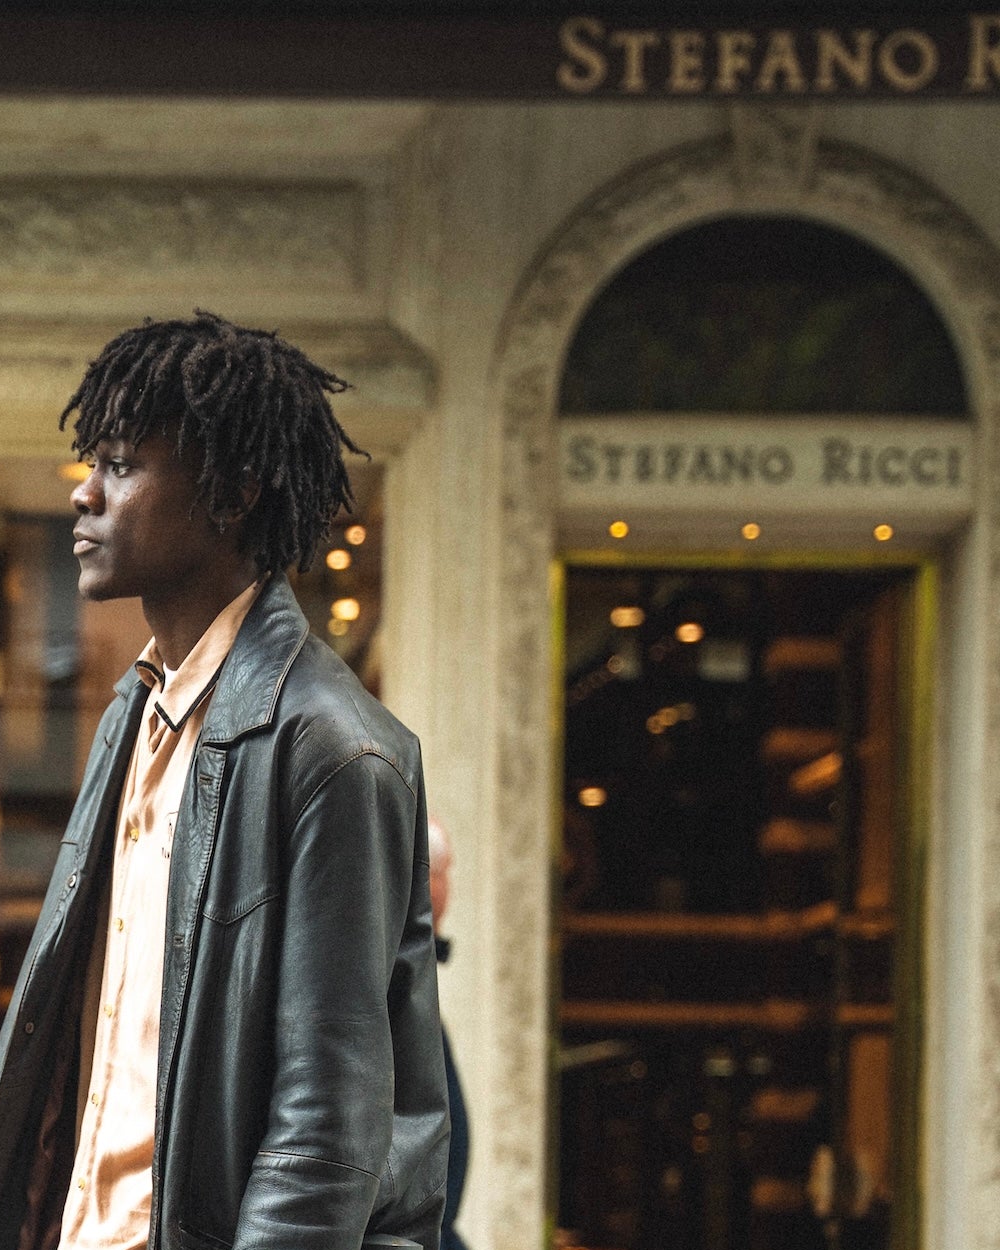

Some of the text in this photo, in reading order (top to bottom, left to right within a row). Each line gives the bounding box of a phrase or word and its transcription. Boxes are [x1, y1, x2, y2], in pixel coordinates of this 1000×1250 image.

[557, 16, 939, 94] STEFANO
[567, 435, 961, 487] STEFANO RICCI
